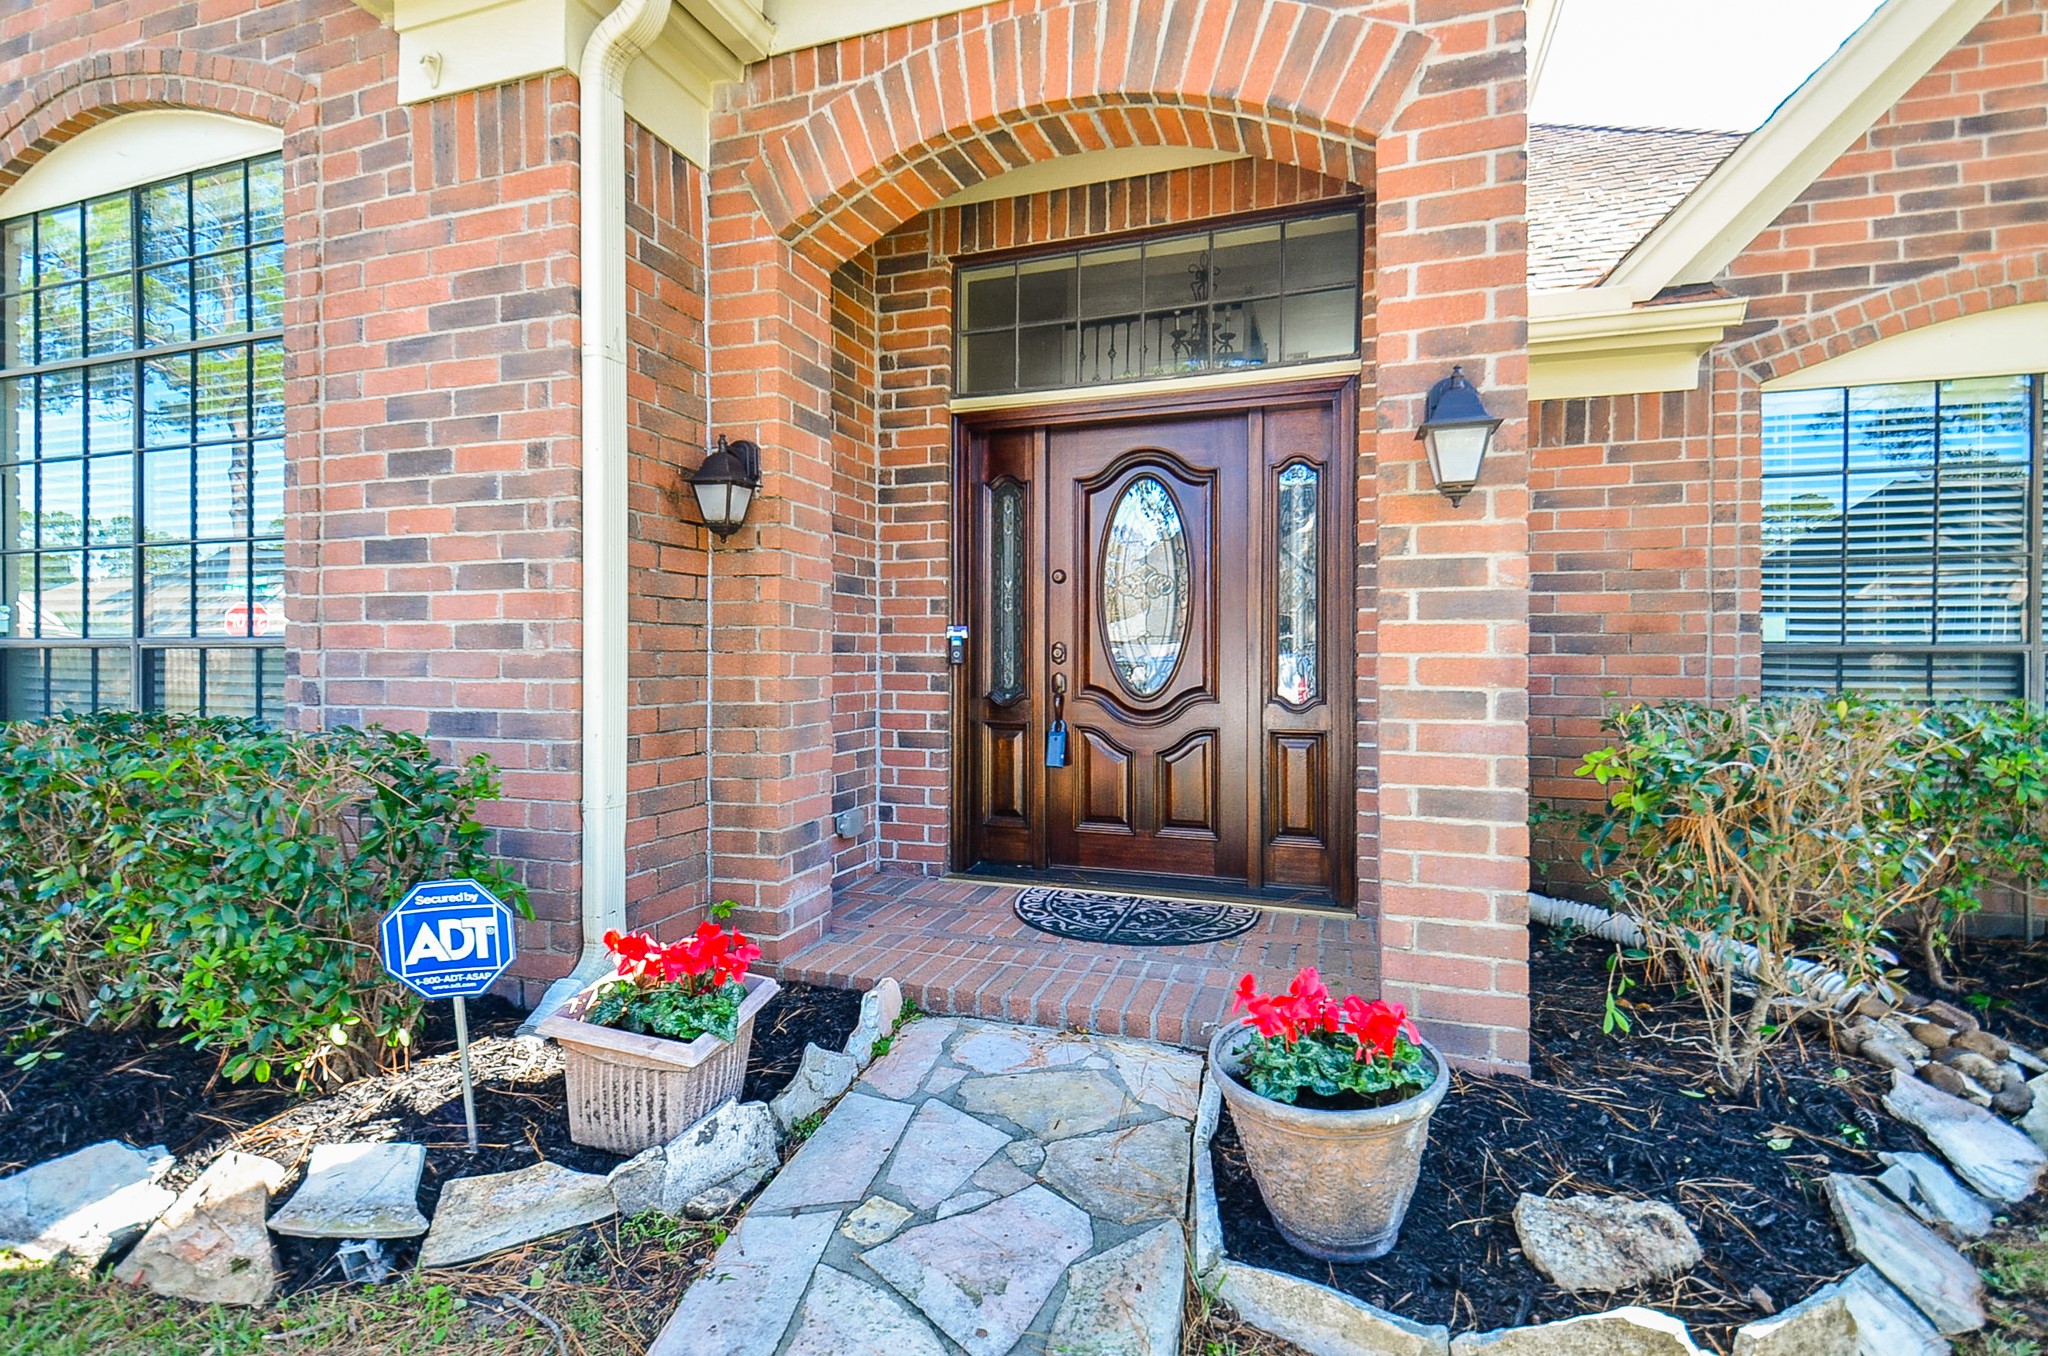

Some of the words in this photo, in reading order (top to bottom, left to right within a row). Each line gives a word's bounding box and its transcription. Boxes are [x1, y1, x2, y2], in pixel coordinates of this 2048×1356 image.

[414, 892, 464, 906] Secured
[464, 891, 479, 903] by
[404, 916, 496, 966] ADT
[414, 972, 492, 985] 1-800-ADT-ASAP
